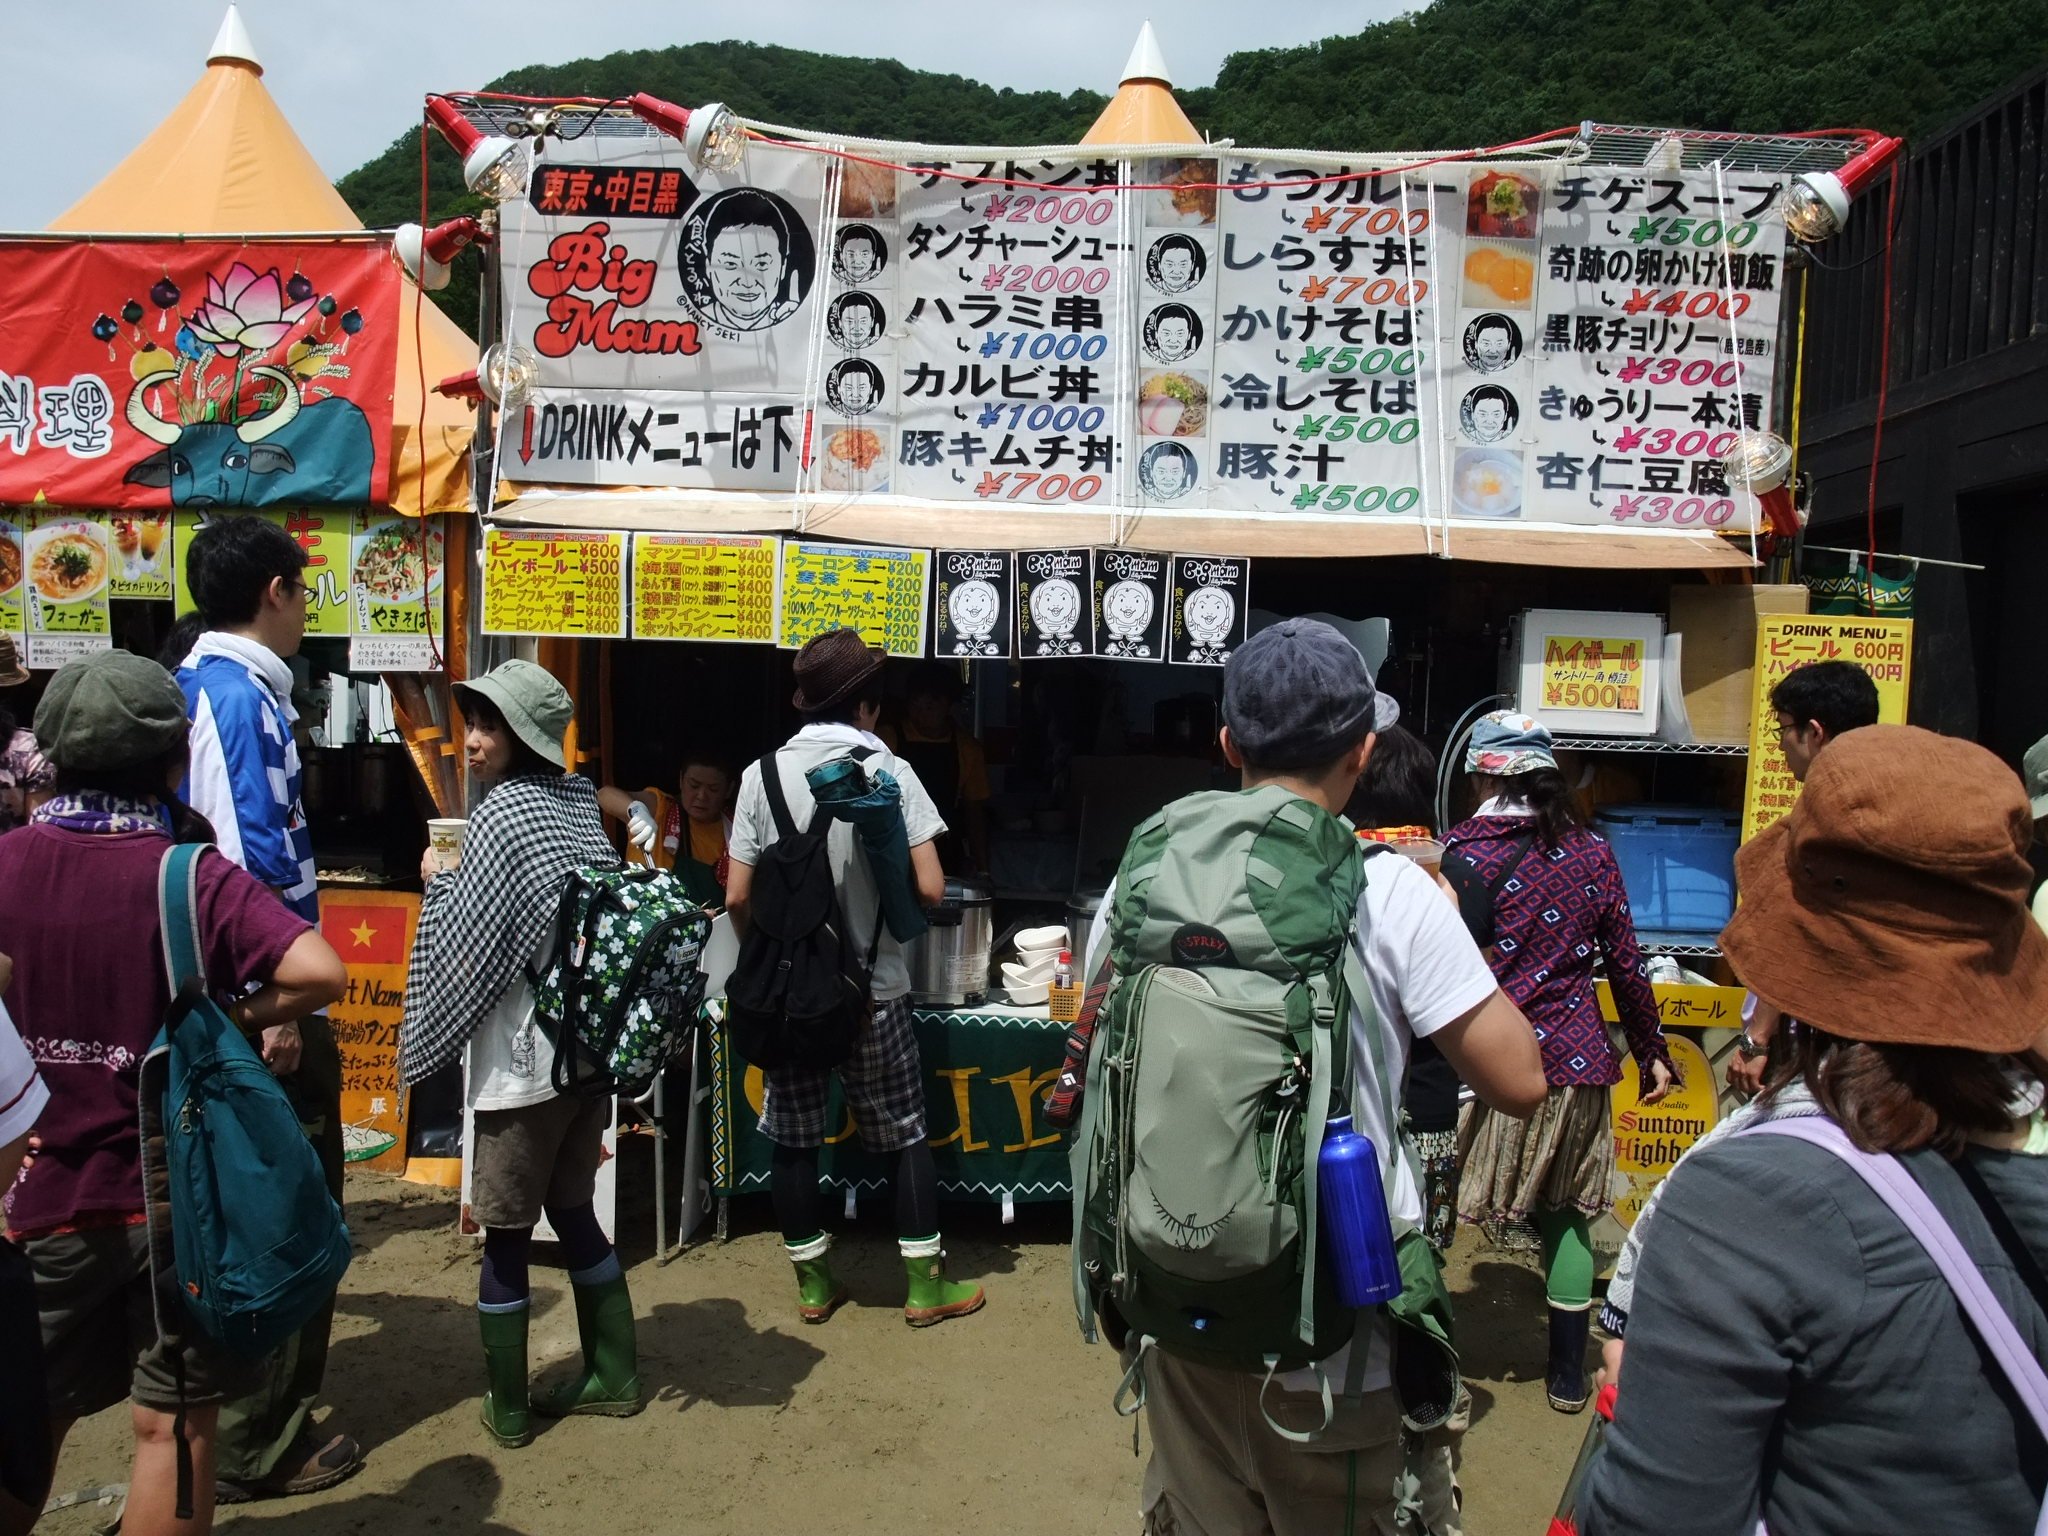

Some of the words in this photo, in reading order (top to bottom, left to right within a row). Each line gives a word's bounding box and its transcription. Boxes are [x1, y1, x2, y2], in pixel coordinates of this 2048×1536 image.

[539, 169, 680, 214] 東京・中目黒
[1227, 162, 1457, 204] もつカレー
[1553, 177, 1783, 219] チゲスープ
[983, 194, 1113, 225] ¥2000
[1302, 206, 1430, 235] ¥700
[907, 222, 1133, 263] タンチャーシュー
[1628, 216, 1758, 248] ¥500
[528, 221, 657, 308] Big
[1223, 233, 1427, 277] しらす丼
[1548, 244, 1777, 291] 奇跡の卵かけ御飯
[981, 264, 1110, 295] ¥2000
[1299, 276, 1428, 306] ¥700
[905, 295, 1103, 333] ハラミ串
[1622, 288, 1752, 320] ¥400
[534, 296, 702, 358] Mam
[715, 326, 741, 342] SEKI
[1221, 304, 1424, 346] かけそば
[979, 331, 1108, 361] ¥1000
[1296, 346, 1424, 376] ¥500
[902, 362, 1100, 404] カルビ丼
[1617, 357, 1745, 387] ¥300
[1219, 372, 1418, 415] 冷しそば
[1539, 385, 1763, 431] きゅうり一本漬
[977, 403, 1105, 433] ¥1000
[1293, 414, 1420, 444] ¥500
[538, 403, 795, 474] DRINKメニューは下
[899, 429, 1122, 473] 豚キムチ丼
[1613, 426, 1739, 458] ¥300
[1216, 443, 1345, 482] 豚汁
[1537, 452, 1731, 497] 杏仁豆腐
[974, 471, 1102, 501] ¥700
[1290, 483, 1419, 513] ¥500
[1610, 495, 1735, 526] ¥300
[491, 541, 565, 558] ビール
[643, 547, 717, 561] マッコリ
[490, 558, 568, 574] ハイボール
[490, 574, 571, 589] レモンサワー
[43, 605, 103, 626] フォーガー
[490, 616, 566, 632] ウーロンハイ
[642, 606, 710, 621] 赤ワイン
[642, 621, 720, 637] ホットワイン
[1782, 624, 1832, 637] DRINK
[1839, 627, 1887, 639] MENU
[1545, 639, 1640, 671] ハイボール
[1771, 637, 1842, 658] ビール
[1854, 642, 1904, 661] 600円
[1547, 683, 1617, 708] ¥500
[1177, 934, 1227, 951] OSPREY
[1657, 1100, 1689, 1110] Quality
[1616, 1110, 1705, 1141] Suntory
